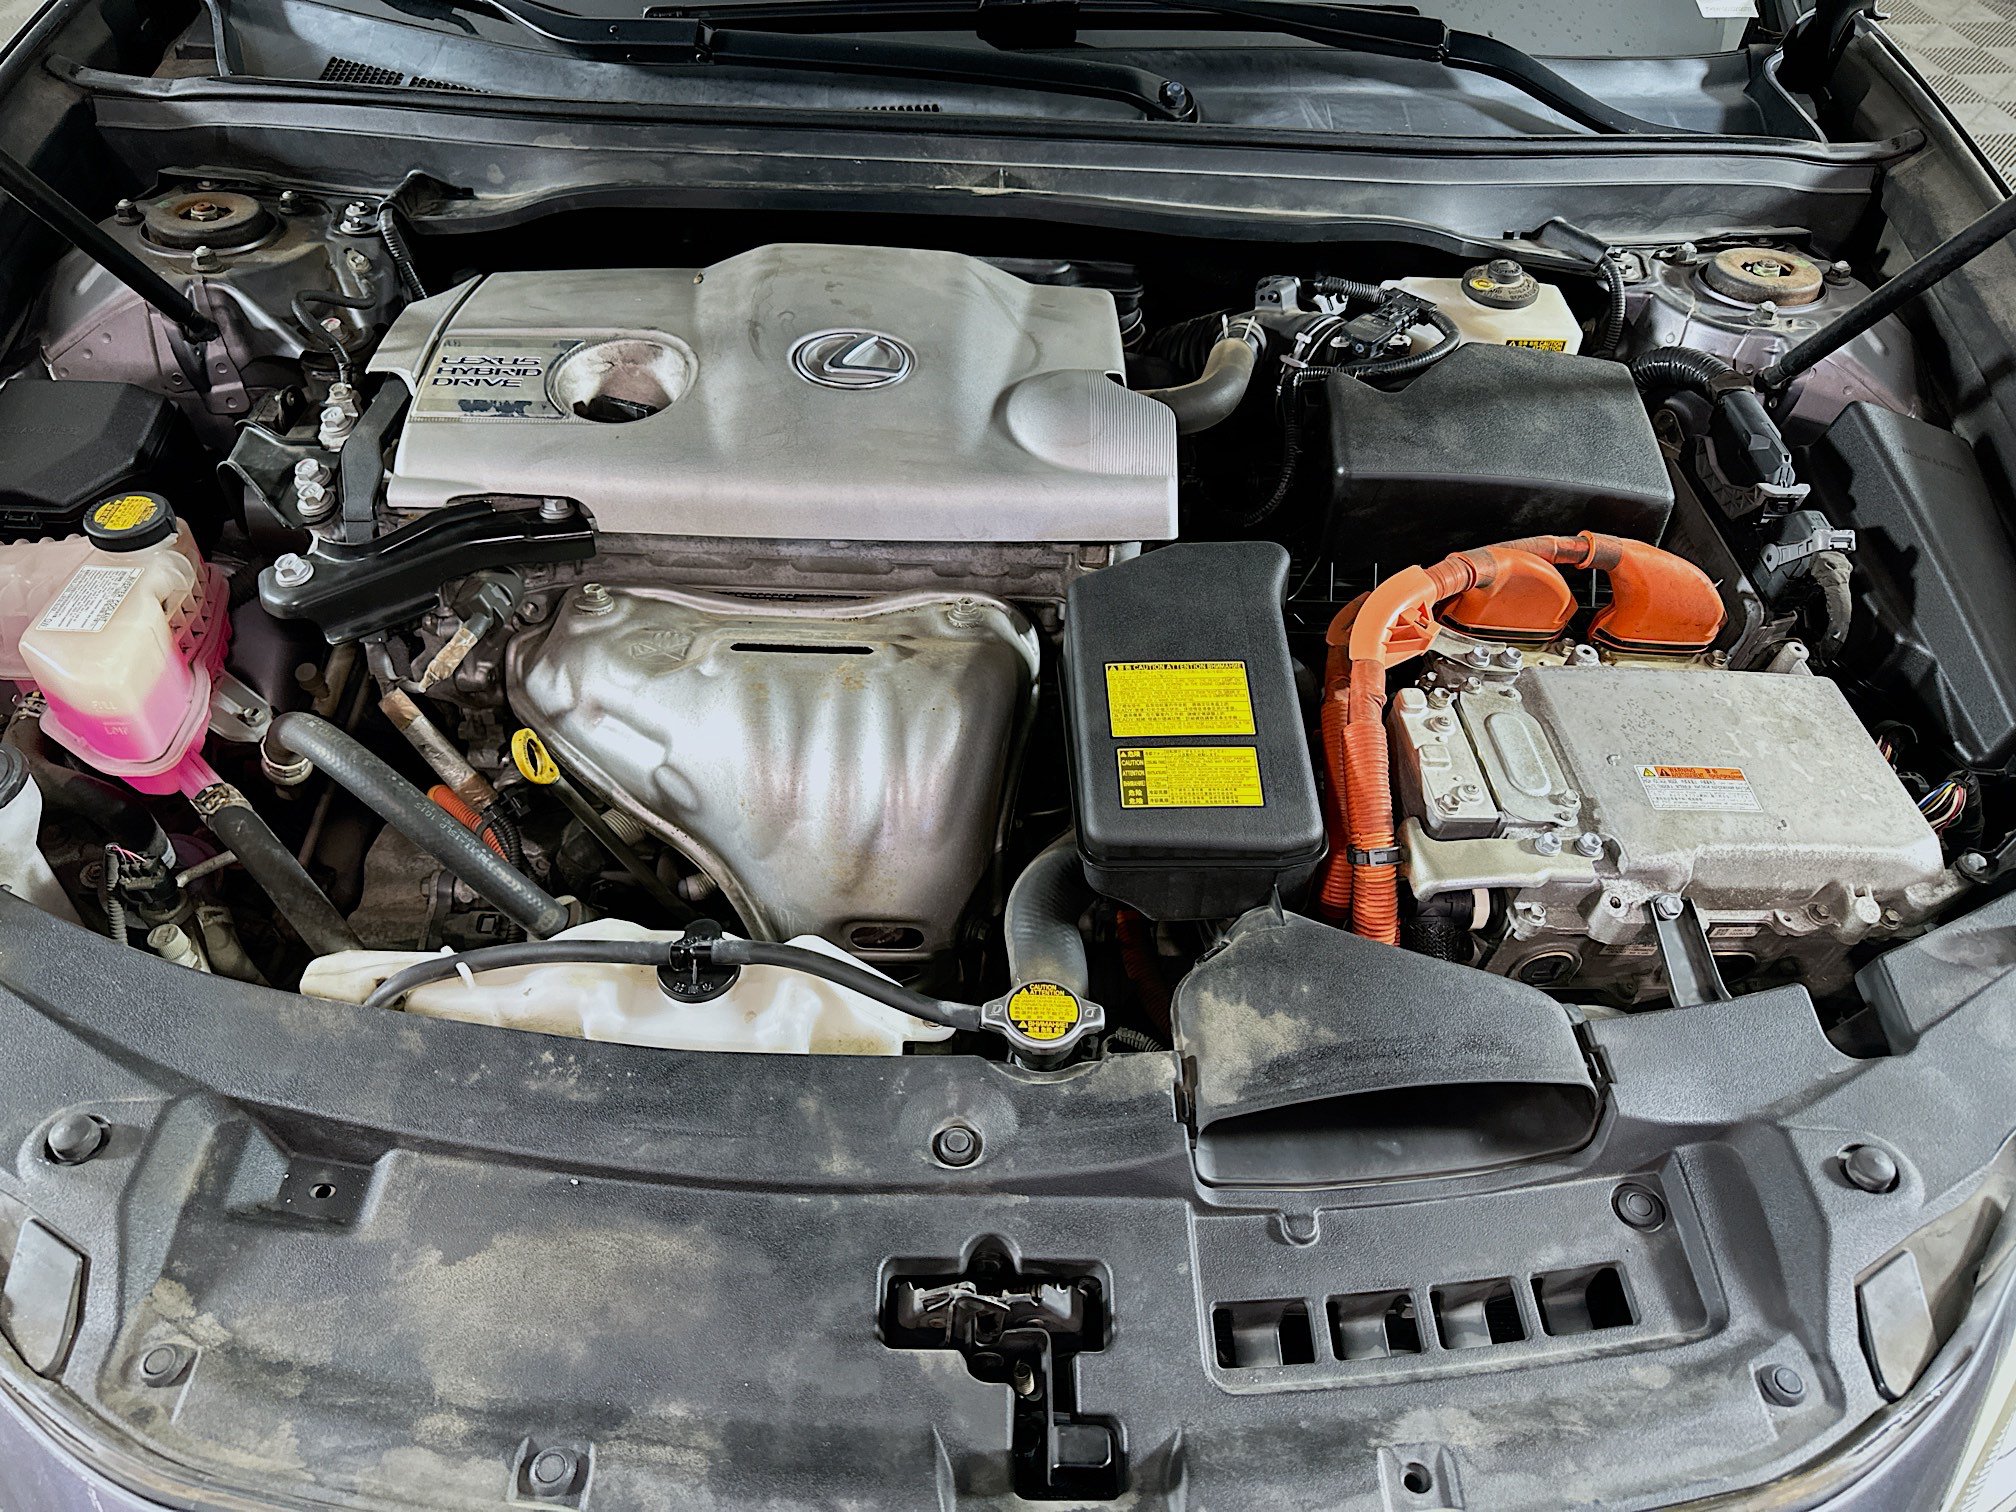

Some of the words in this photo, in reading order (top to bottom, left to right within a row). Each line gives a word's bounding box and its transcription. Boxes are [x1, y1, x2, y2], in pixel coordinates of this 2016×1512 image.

[441, 355, 541, 365] LEXUS
[436, 366, 543, 377] HYBRID
[432, 377, 524, 387] DRIVE
